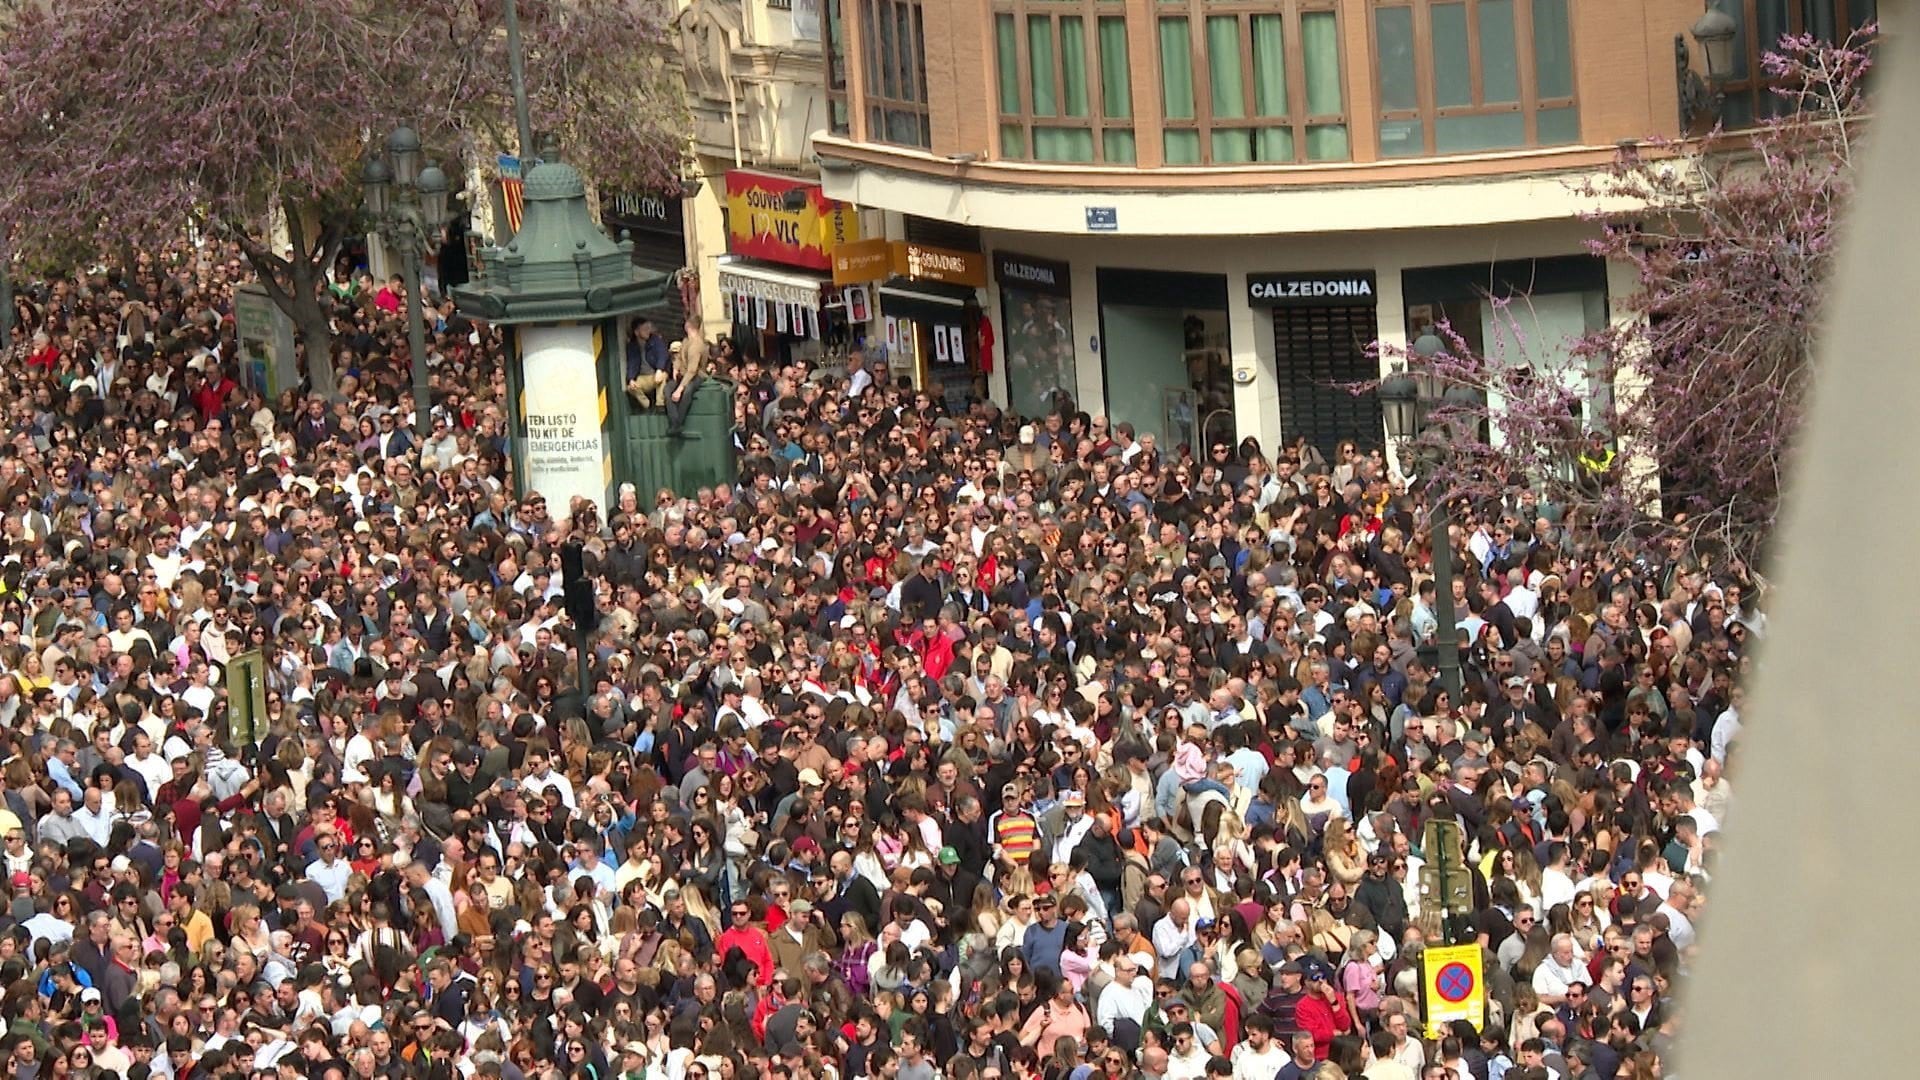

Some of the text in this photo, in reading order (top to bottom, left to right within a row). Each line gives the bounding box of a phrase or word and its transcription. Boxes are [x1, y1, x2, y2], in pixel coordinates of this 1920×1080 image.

[747, 191, 800, 215] SOUVEN
[775, 218, 800, 245] VLC
[1003, 262, 1055, 285] CALZEDONIA
[1250, 279, 1372, 298] CALZEDONIA
[528, 413, 576, 426] TEN LISTO
[529, 428, 574, 439] TU KIT DE
[530, 439, 598, 452] EMERGENCIAS
